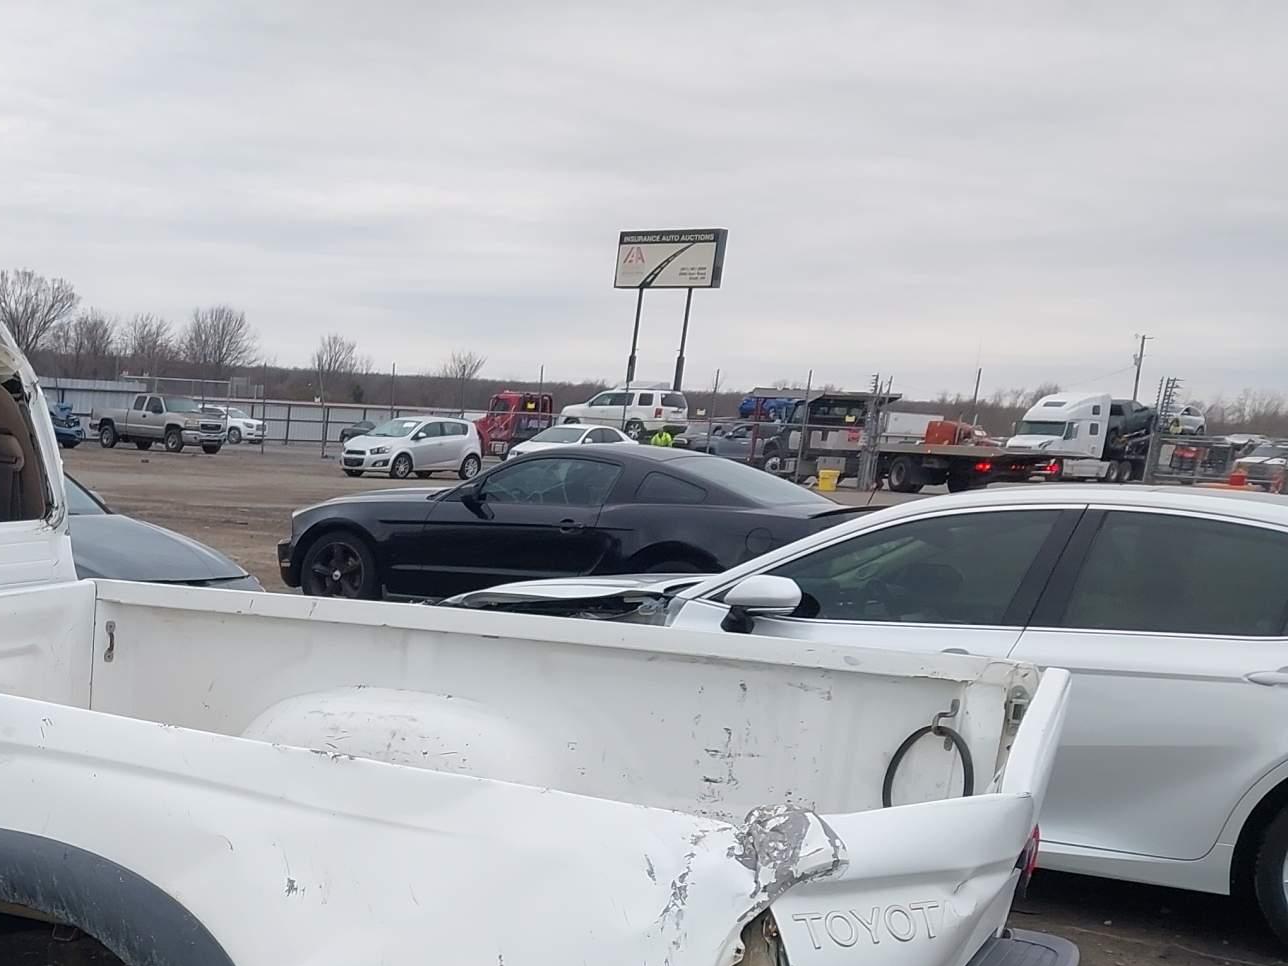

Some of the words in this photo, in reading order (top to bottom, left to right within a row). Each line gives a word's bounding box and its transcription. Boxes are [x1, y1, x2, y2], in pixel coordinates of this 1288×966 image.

[623, 234, 661, 243] INSURANCE
[661, 234, 680, 242] AUTO
[680, 233, 715, 242] AUCTIONS
